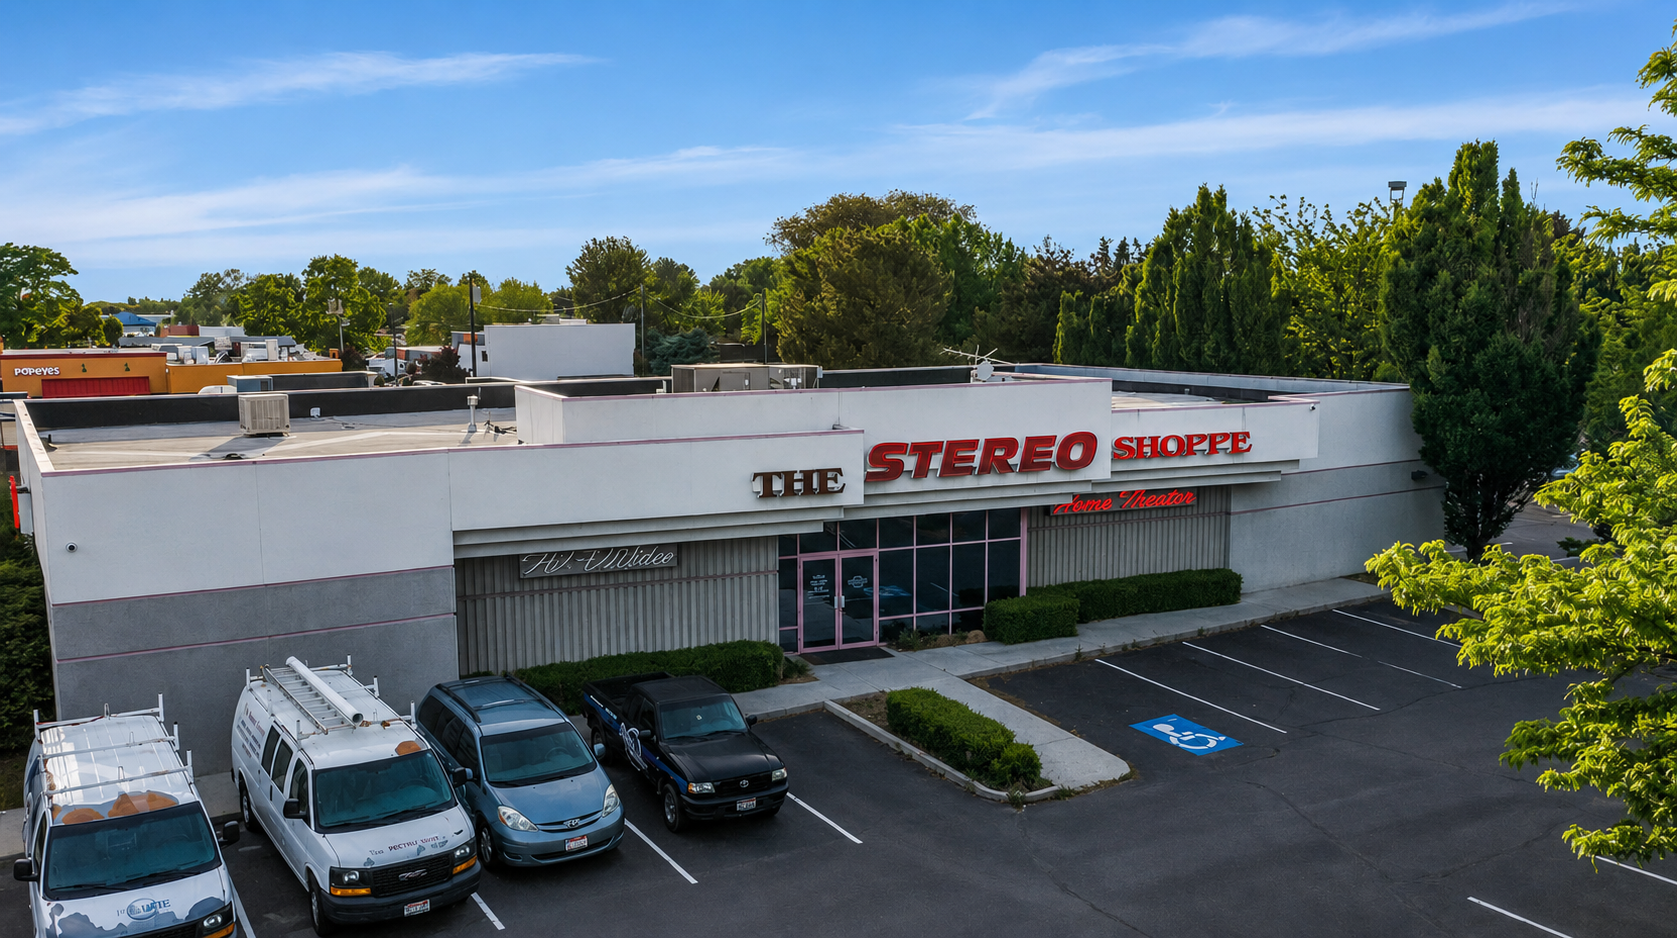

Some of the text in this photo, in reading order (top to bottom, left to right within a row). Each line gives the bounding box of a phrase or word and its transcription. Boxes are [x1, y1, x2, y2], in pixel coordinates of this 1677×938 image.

[752, 431, 1252, 498] THE STEREO SHOPPE
[1119, 489, 1197, 509] Theator
